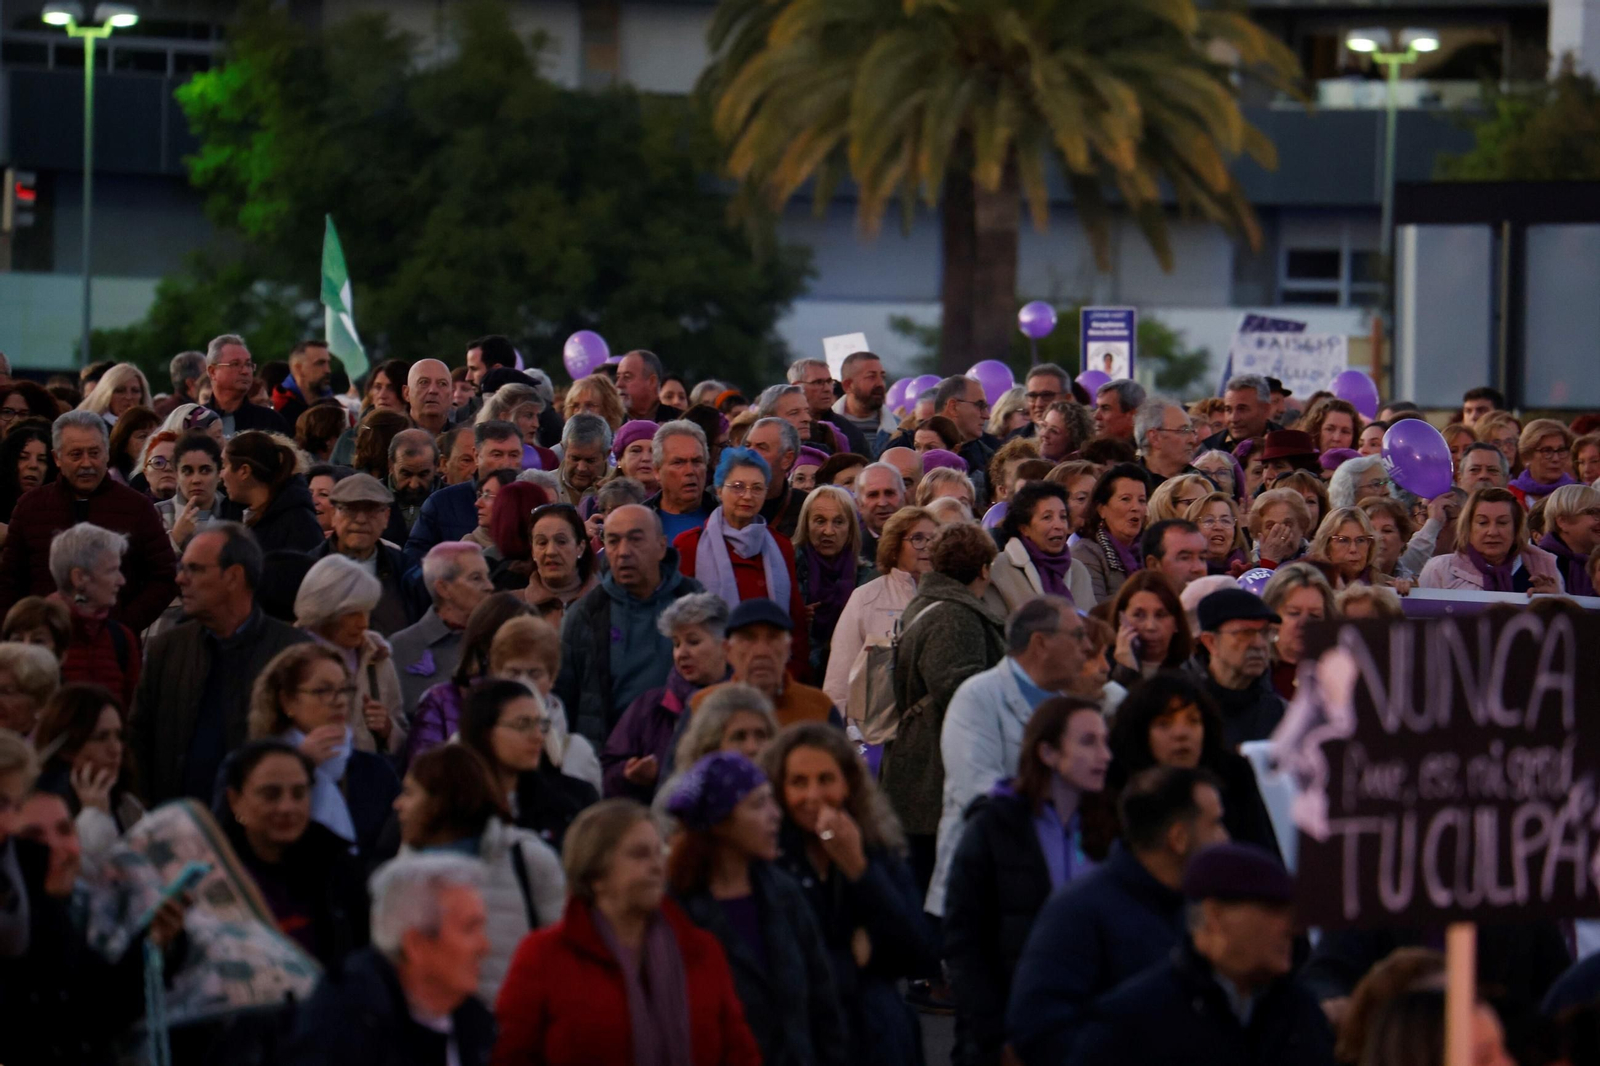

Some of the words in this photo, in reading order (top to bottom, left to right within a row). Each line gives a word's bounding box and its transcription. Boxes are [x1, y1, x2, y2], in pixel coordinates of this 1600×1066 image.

[1337, 612, 1576, 734] NUNCA
[1328, 808, 1418, 920] TU
[1422, 802, 1588, 908] CULPA
